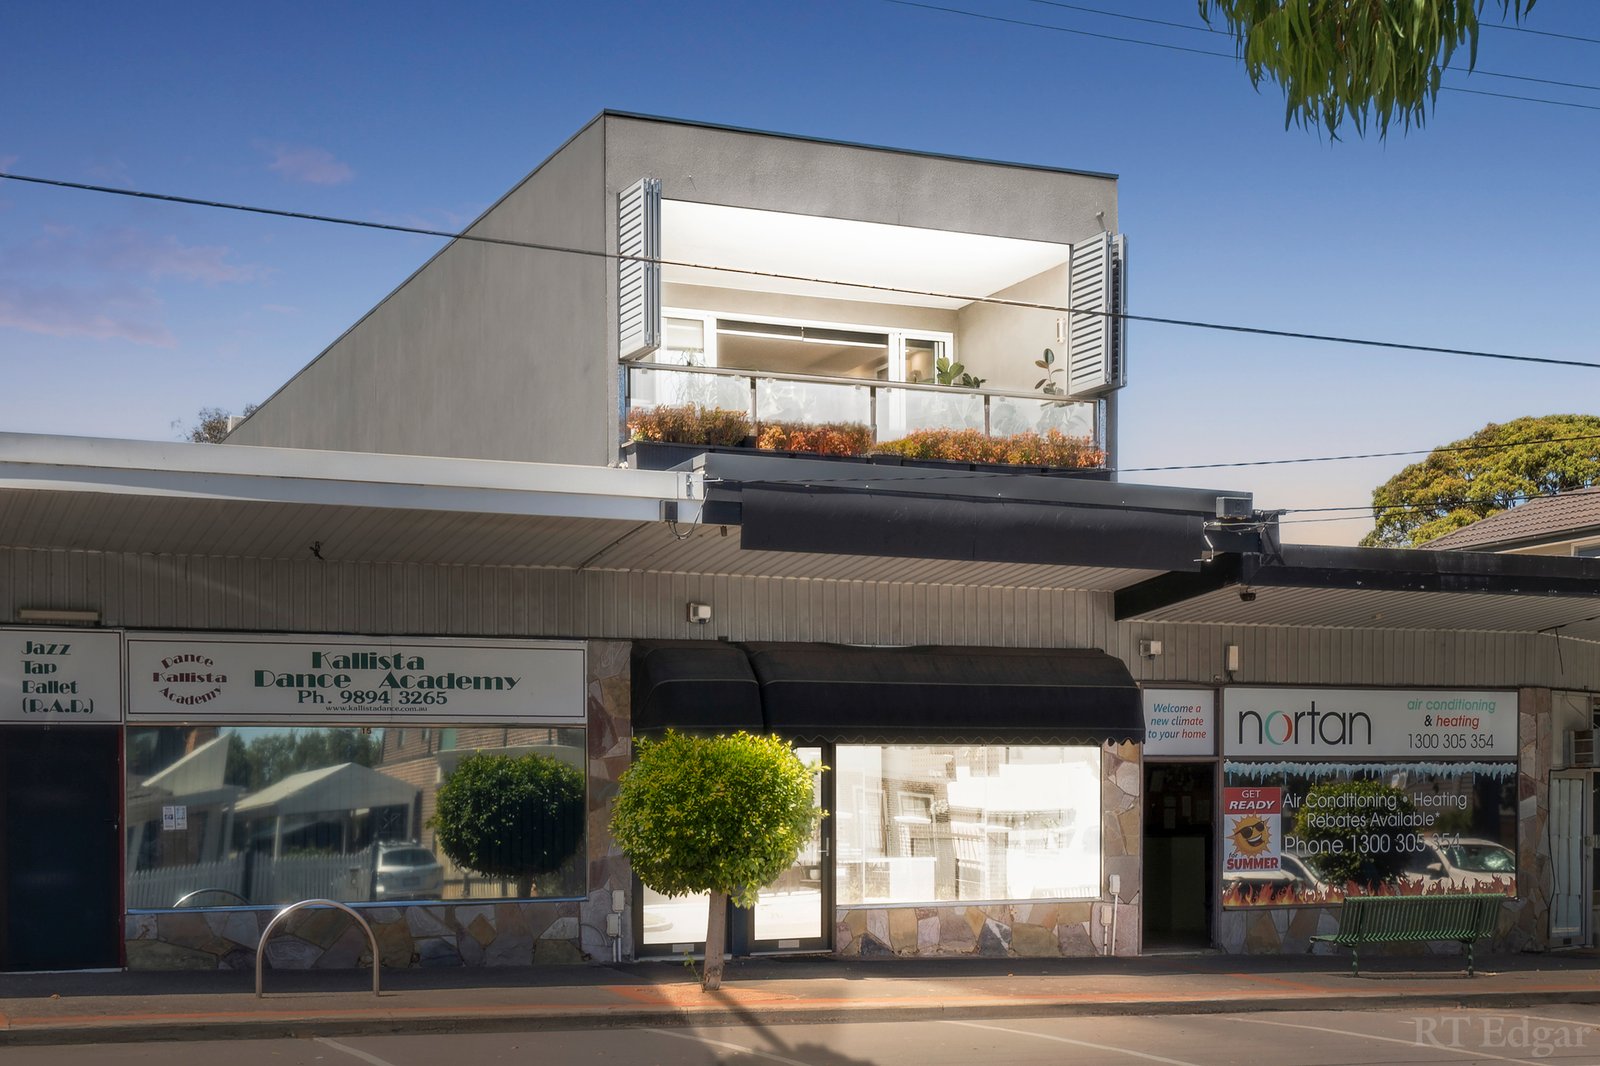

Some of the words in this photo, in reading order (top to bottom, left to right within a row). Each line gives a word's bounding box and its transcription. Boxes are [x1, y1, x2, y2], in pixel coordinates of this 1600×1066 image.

[21, 641, 71, 655] Jazz
[21, 661, 57, 675] Tap
[161, 654, 213, 669] Dance
[312, 651, 424, 670] Kallista
[152, 672, 227, 683] Kallista
[254, 669, 351, 688] Dance
[378, 671, 521, 691] Academy
[22, 680, 79, 694] Ballet
[159, 685, 222, 705] Academy
[298, 690, 332, 704] Ph.
[340, 690, 390, 705] 9894
[399, 691, 447, 705] 3265
[22, 699, 94, 713] (R.A.D.)
[1153, 703, 1194, 714] Welcome
[1195, 706, 1201, 714] a
[1407, 699, 1423, 711] air
[1425, 698, 1496, 714] conditioning
[1150, 718, 1169, 726] new
[1170, 716, 1204, 726] climate
[1238, 700, 1372, 745] nortan
[1424, 715, 1433, 727] &
[1436, 714, 1480, 730] heating
[1148, 730, 1157, 739] to
[1158, 731, 1180, 741] your
[1181, 728, 1207, 739] home
[1407, 734, 1439, 749] 1300
[1442, 734, 1468, 749] 305
[1470, 734, 1494, 749] 354
[1241, 789, 1260, 798] GET
[1228, 799, 1276, 810] READY
[1282, 793, 1301, 808] Air
[1305, 792, 1397, 811] Conditioning
[1414, 792, 1467, 810] Heating
[1307, 812, 1367, 828] Rebates
[1284, 836, 1343, 855] Phone
[1351, 835, 1390, 853] 1300
[1395, 834, 1426, 852] 305
[1226, 857, 1279, 870] SUMMER
